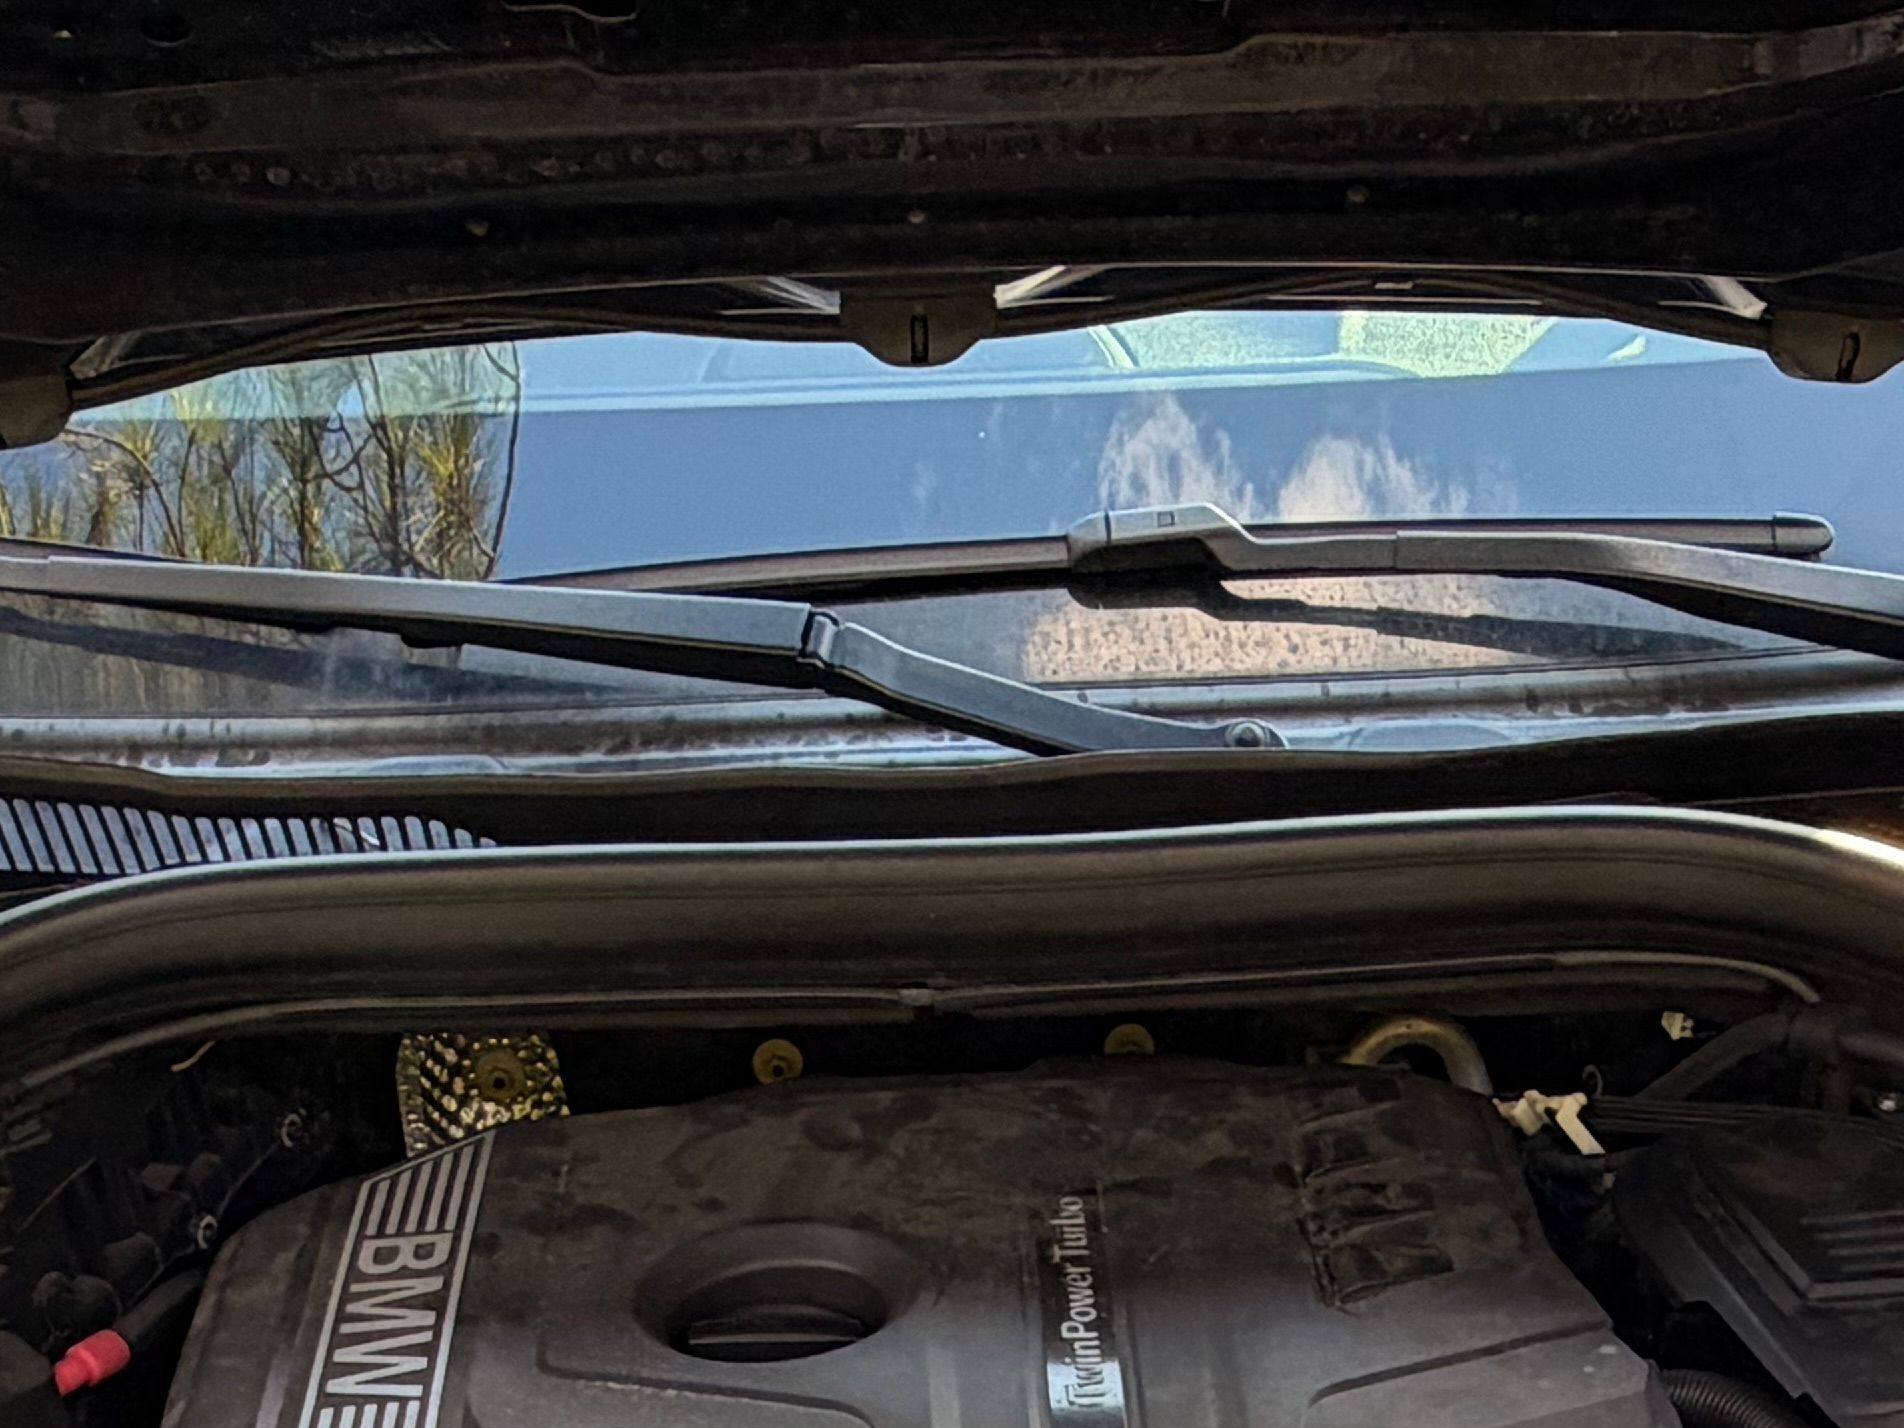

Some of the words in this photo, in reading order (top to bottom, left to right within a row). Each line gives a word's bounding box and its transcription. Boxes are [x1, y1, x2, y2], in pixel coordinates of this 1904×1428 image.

[1049, 1196, 1089, 1262] Turbo
[325, 1233, 453, 1396] BMW
[1060, 1263, 1105, 1406] TwinPower
